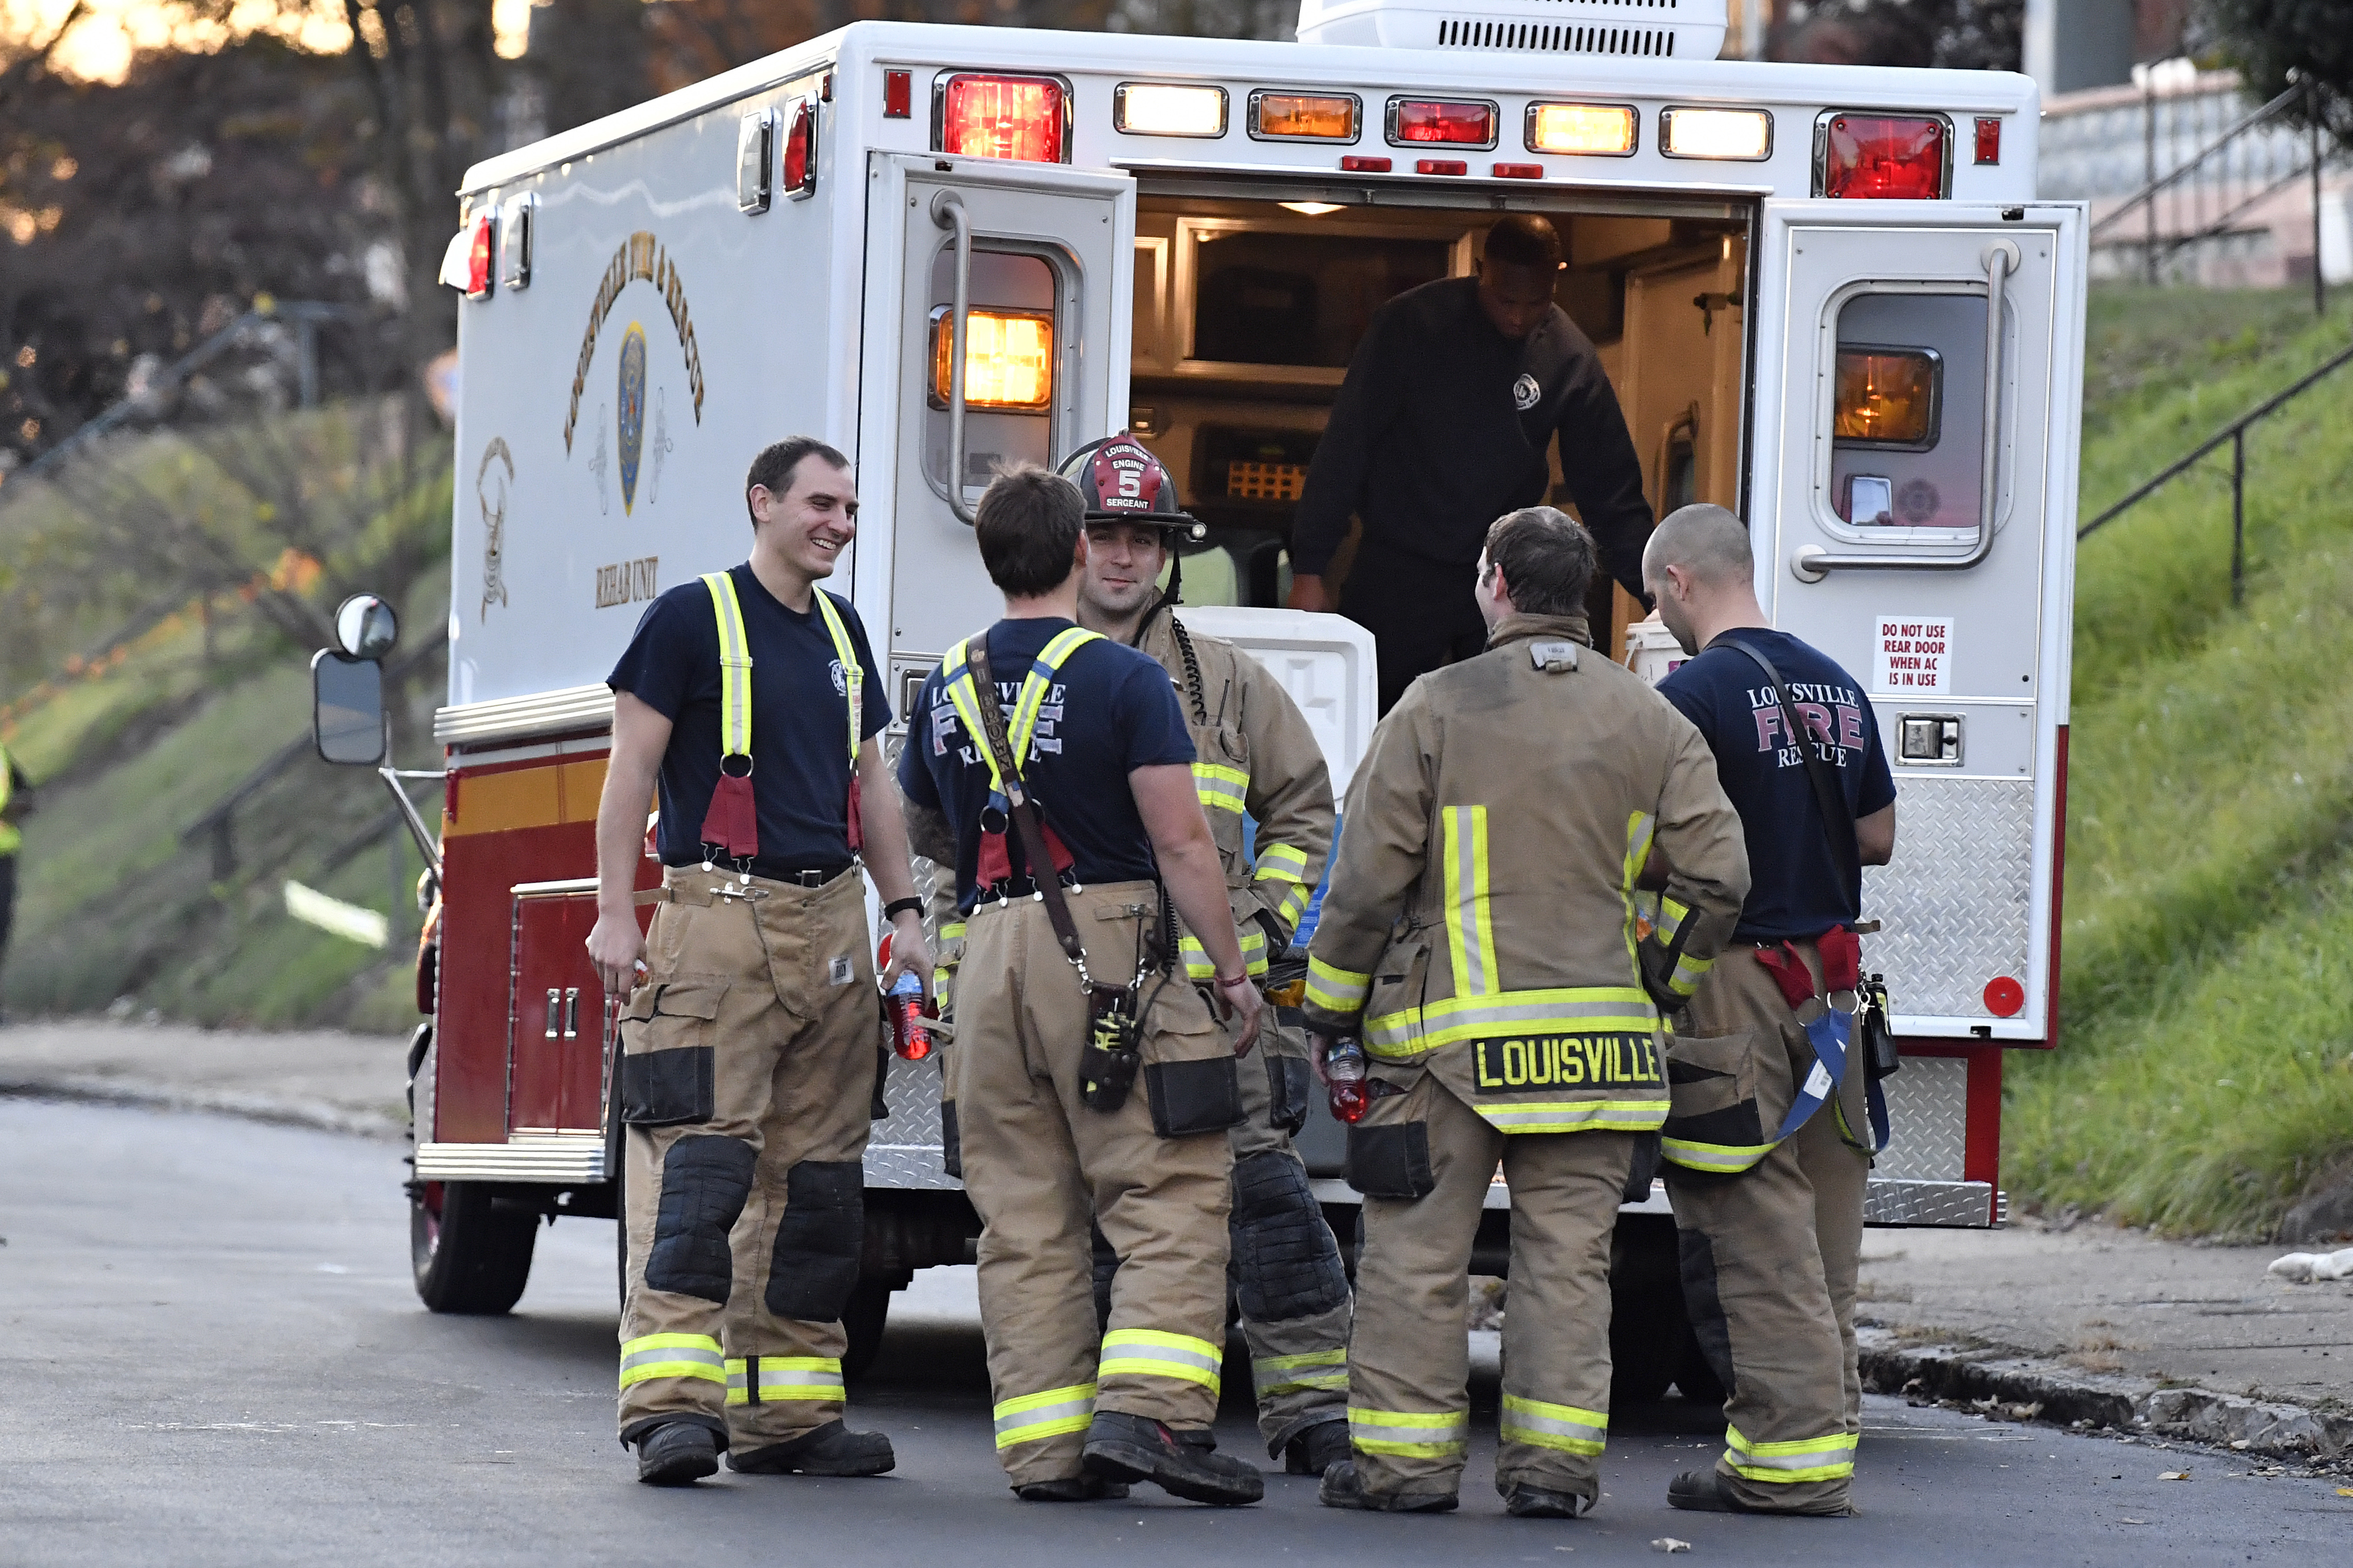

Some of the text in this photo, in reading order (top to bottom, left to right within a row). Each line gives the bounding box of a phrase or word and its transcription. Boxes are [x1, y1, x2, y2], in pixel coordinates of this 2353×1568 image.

[1105, 444, 1149, 461] LOUISVILLE
[1112, 459, 1145, 471] ENGINE
[1119, 469, 1141, 497] 5
[1106, 498, 1149, 509] SERGEANT
[1882, 623, 1946, 638] DO NOT USE
[1884, 640, 1945, 654] REAR DOOR
[1890, 656, 1938, 670] WHEN AC
[1889, 672, 1937, 686] IS IN USE
[1476, 1037, 1661, 1088] LOUISVILLE
